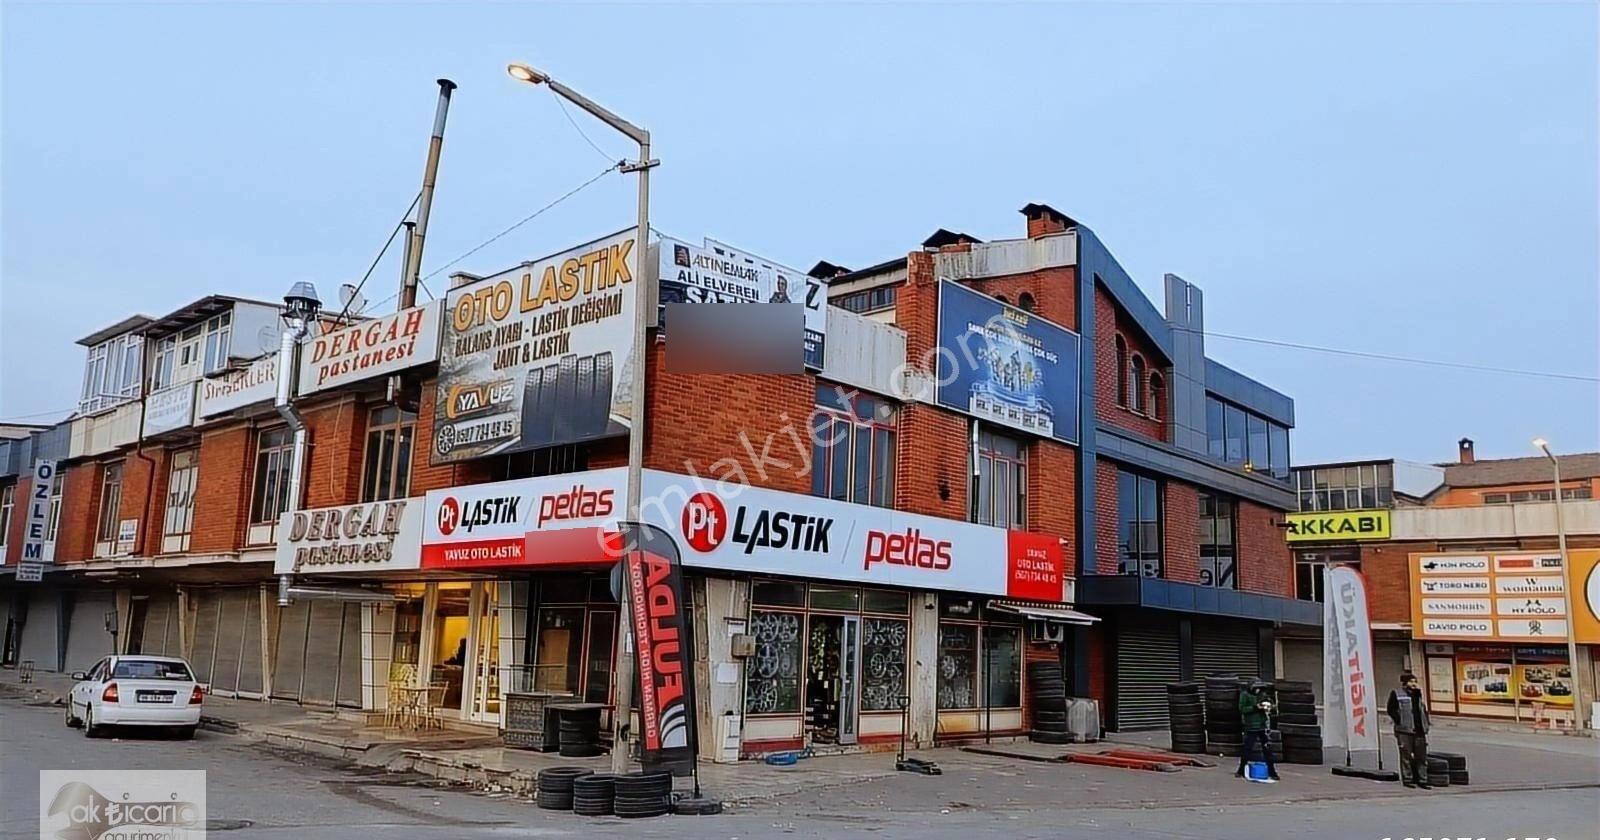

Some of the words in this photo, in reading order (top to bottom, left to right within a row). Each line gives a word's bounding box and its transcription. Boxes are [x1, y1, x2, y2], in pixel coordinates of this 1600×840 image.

[678, 270, 699, 285] ALİ
[704, 277, 760, 300] ELVEREN
[453, 280, 513, 331] OTO
[312, 308, 425, 364] DERGAH
[455, 332, 492, 358] BALANS
[493, 320, 522, 347] AYARI
[317, 336, 416, 385] pastanesi
[493, 345, 521, 371] JANT
[522, 345, 530, 363] &
[460, 385, 514, 411] YAVUZ
[25, 460, 52, 558] ÖZLEM
[288, 501, 406, 541] DERGAH
[440, 504, 454, 530] Pt
[538, 485, 614, 528] petlas
[445, 547, 469, 561] YAVUZ
[471, 547, 489, 559] OTO
[688, 502, 718, 545] Pt
[864, 527, 952, 570] petlas
[292, 540, 393, 572] pastanesi
[1017, 559, 1032, 569] OTO
[1428, 623, 1457, 631] DAVID
[1459, 623, 1487, 631] POLO
